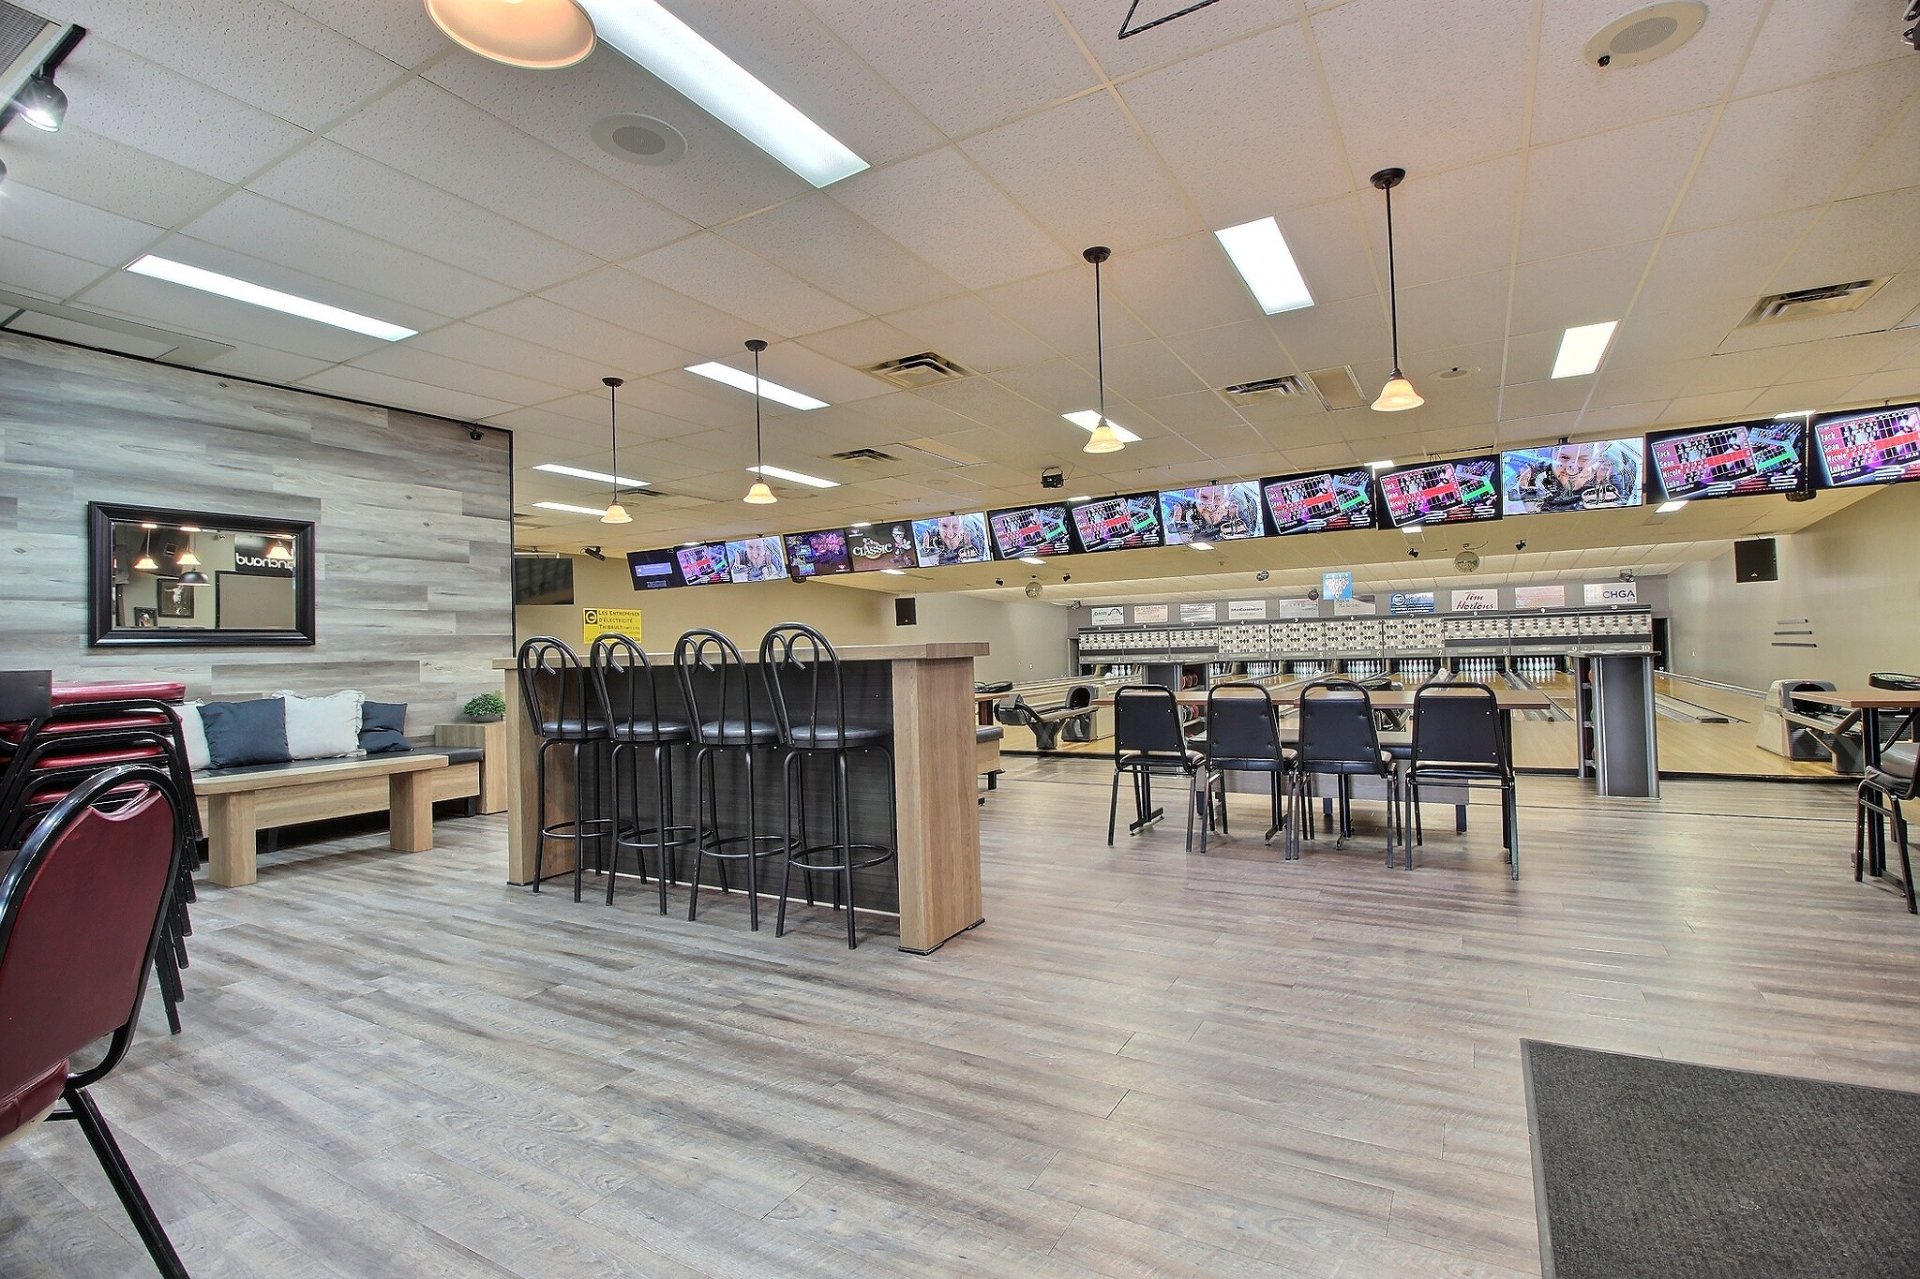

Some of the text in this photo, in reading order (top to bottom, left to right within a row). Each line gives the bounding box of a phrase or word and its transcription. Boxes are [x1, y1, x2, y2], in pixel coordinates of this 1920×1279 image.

[852, 539, 893, 556] CLASSIC
[1465, 591, 1484, 601] Tim
[1603, 590, 1636, 599] CHGA
[1456, 601, 1494, 610] Hortons
